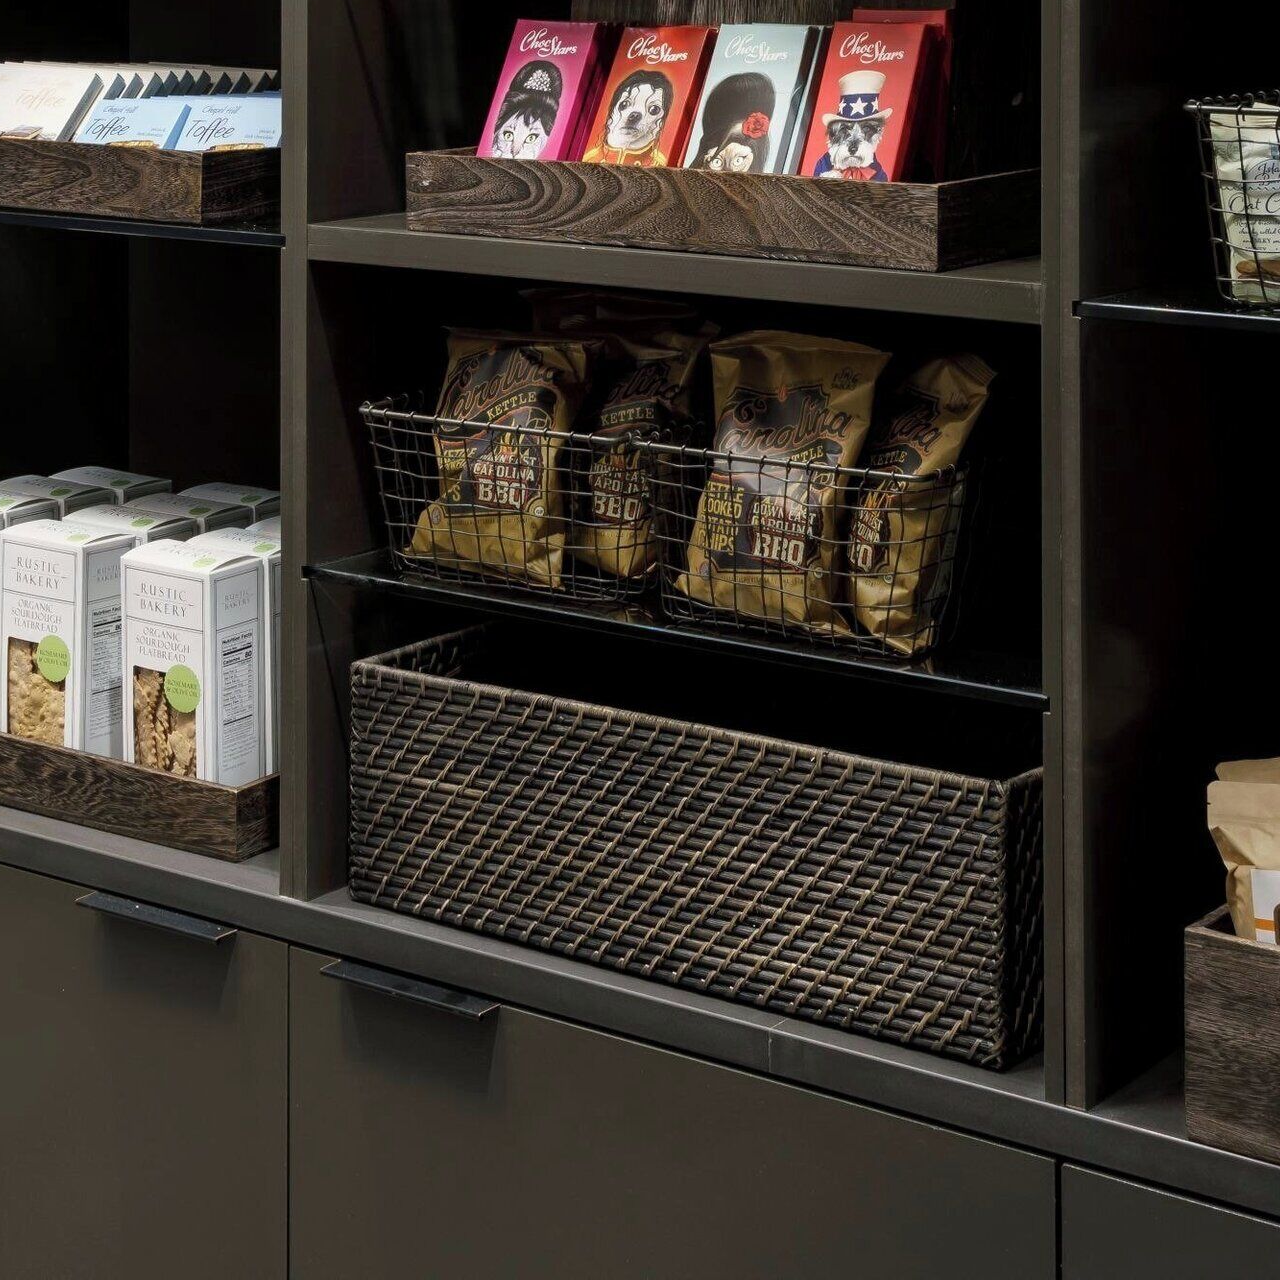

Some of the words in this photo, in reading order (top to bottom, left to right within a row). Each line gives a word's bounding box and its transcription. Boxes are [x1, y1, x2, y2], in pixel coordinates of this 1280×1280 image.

[85, 116, 130, 141] Toffee
[185, 117, 235, 144] Toffee
[486, 391, 537, 421] KETTLE
[601, 407, 655, 426] KETTLE
[478, 478, 527, 509] BBQ
[593, 491, 642, 520] BBQ
[754, 533, 805, 567] BBQ
[16, 556, 60, 574] RUSTIC
[16, 573, 60, 590] BAKERY
[140, 582, 187, 602] RUSTIC
[18, 599, 54, 614] ORGANIC
[140, 598, 187, 618] BAKERY
[12, 609, 62, 624] SOURDOUGH
[14, 618, 58, 633] FLATBREAD
[142, 627, 179, 641] ORGANIC
[135, 635, 190, 654] SOURDOUGH
[139, 646, 187, 663] FLATBREAD
